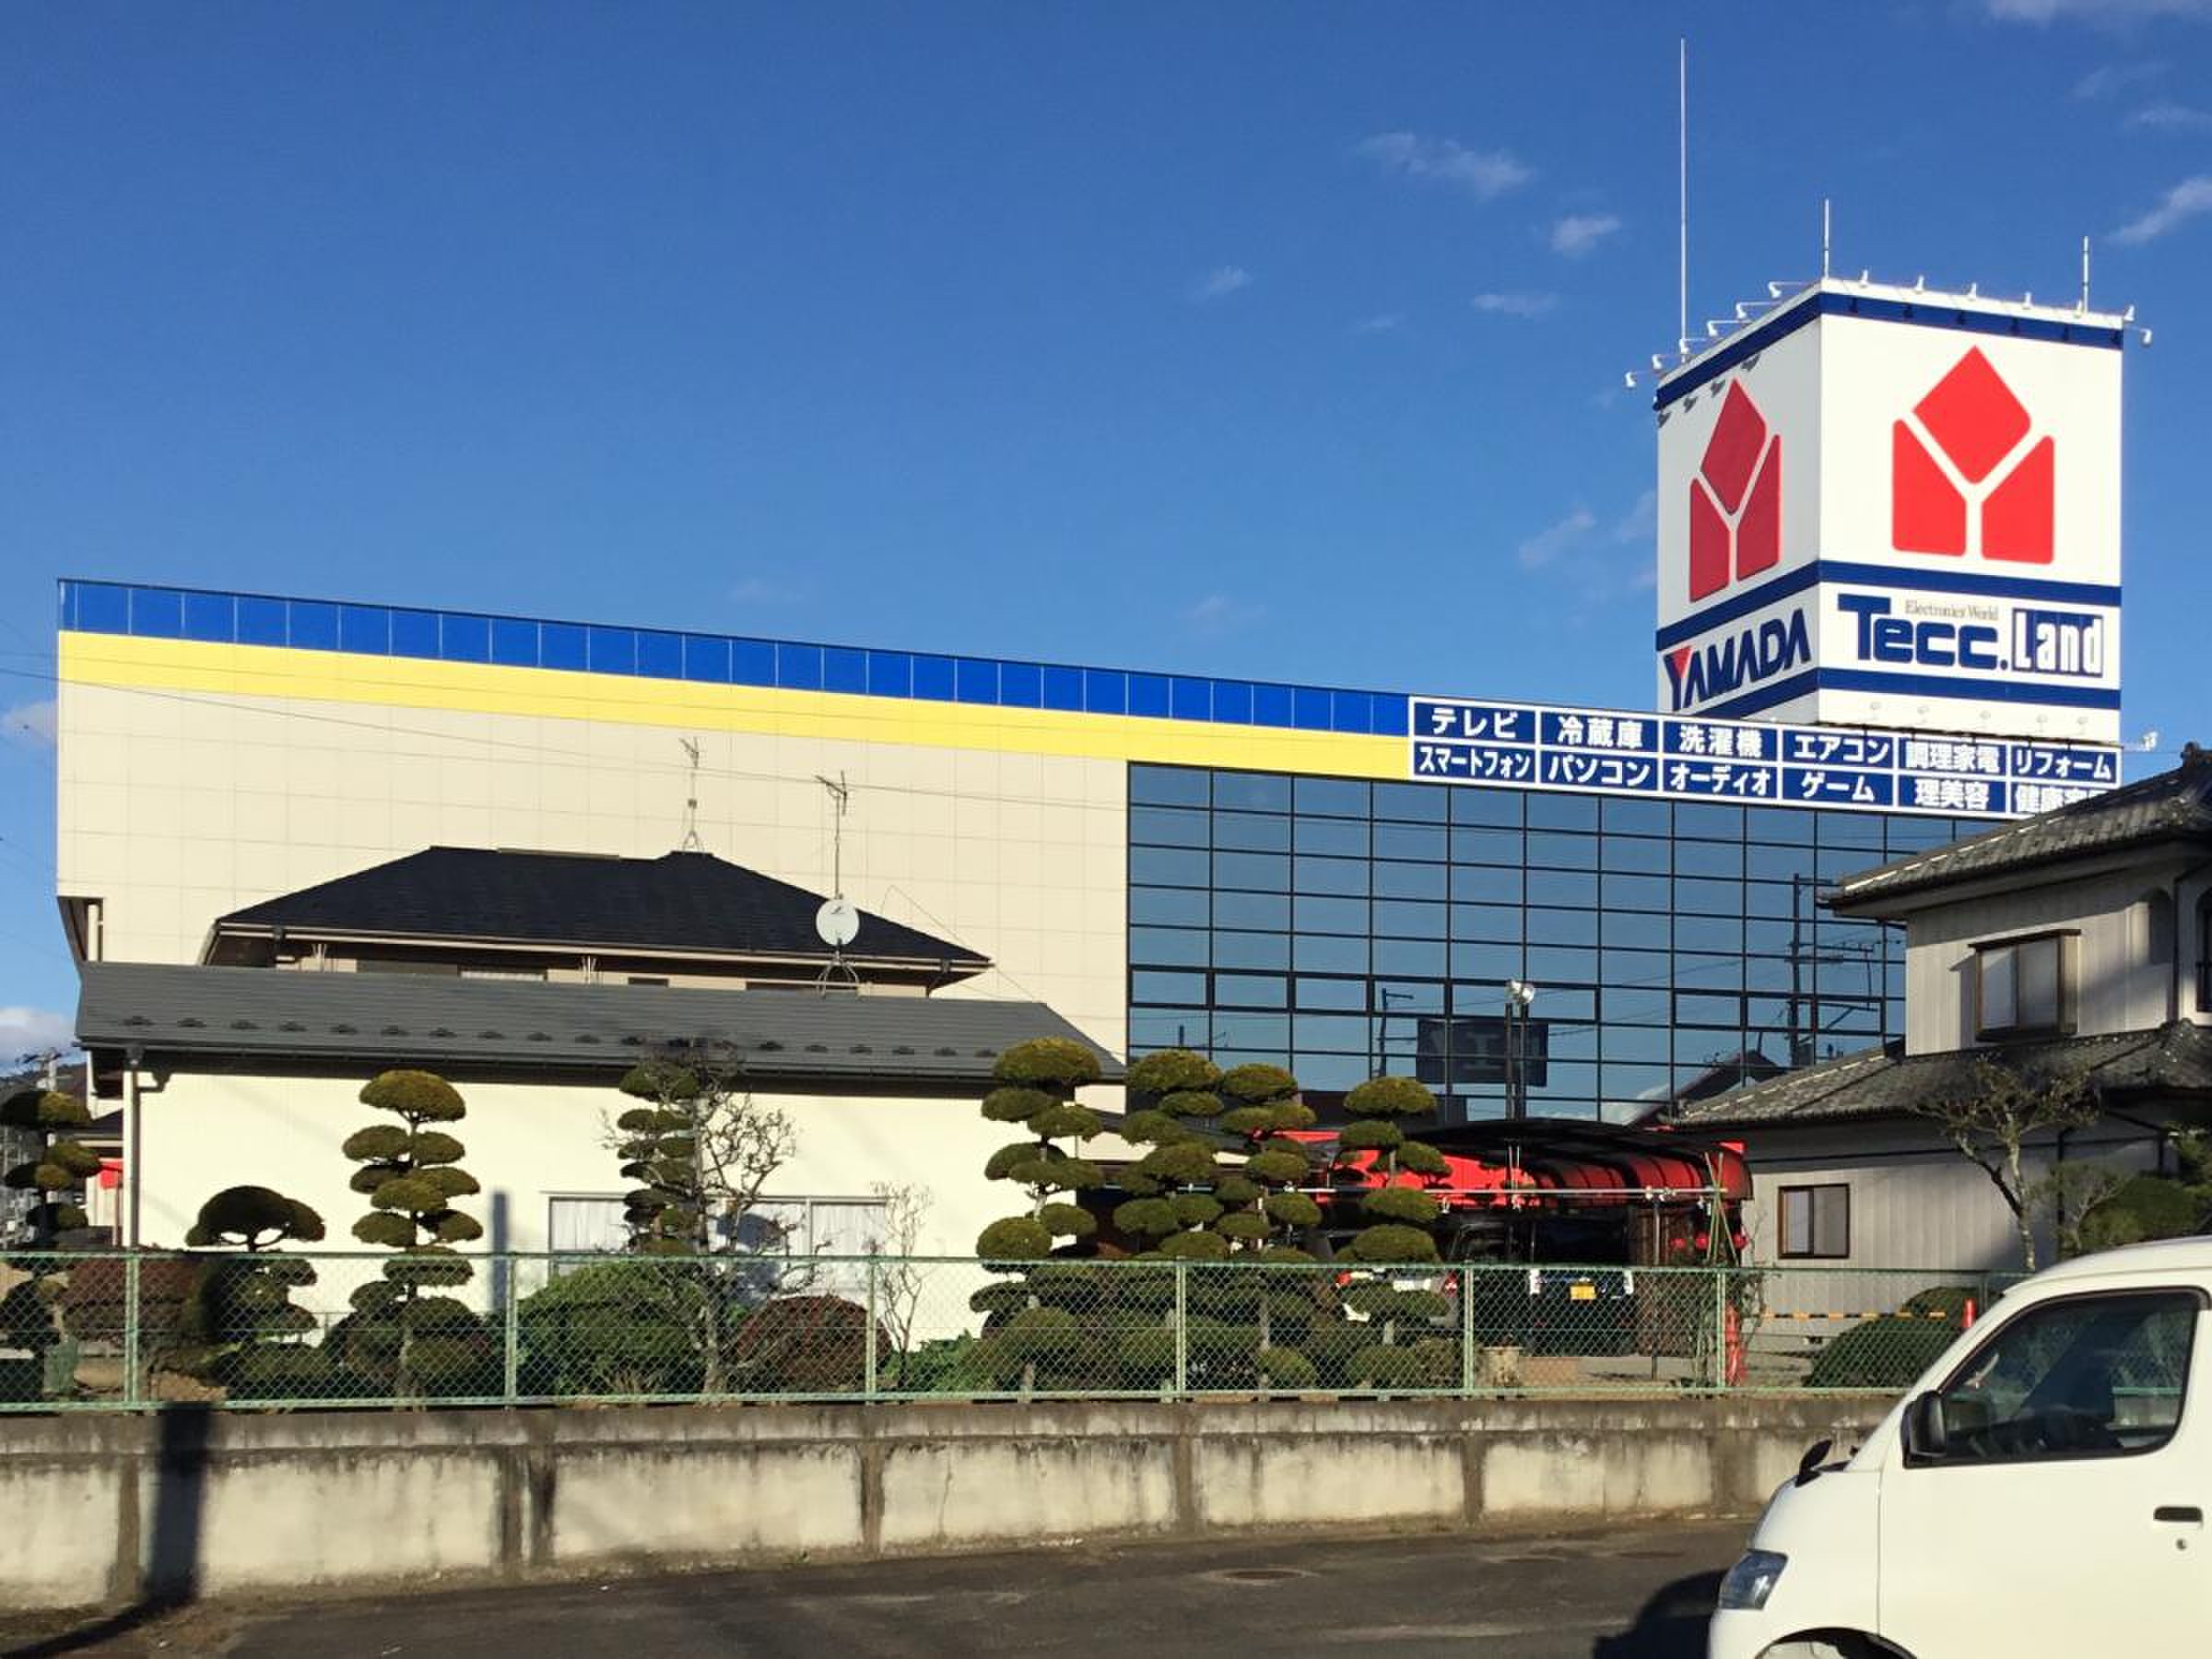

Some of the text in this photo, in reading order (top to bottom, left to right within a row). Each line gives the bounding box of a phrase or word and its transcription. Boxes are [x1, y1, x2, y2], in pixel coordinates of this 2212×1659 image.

[1966, 604, 1999, 621] World
[1663, 606, 1812, 712] YAMADA
[1431, 707, 2112, 780] テレビ 冷蔵庫 洗濯機 エアコン 調理家電 リフォーム
[1418, 746, 2108, 813] スマートフォン パソコン オーディオ ゲーム 理美容 健康
